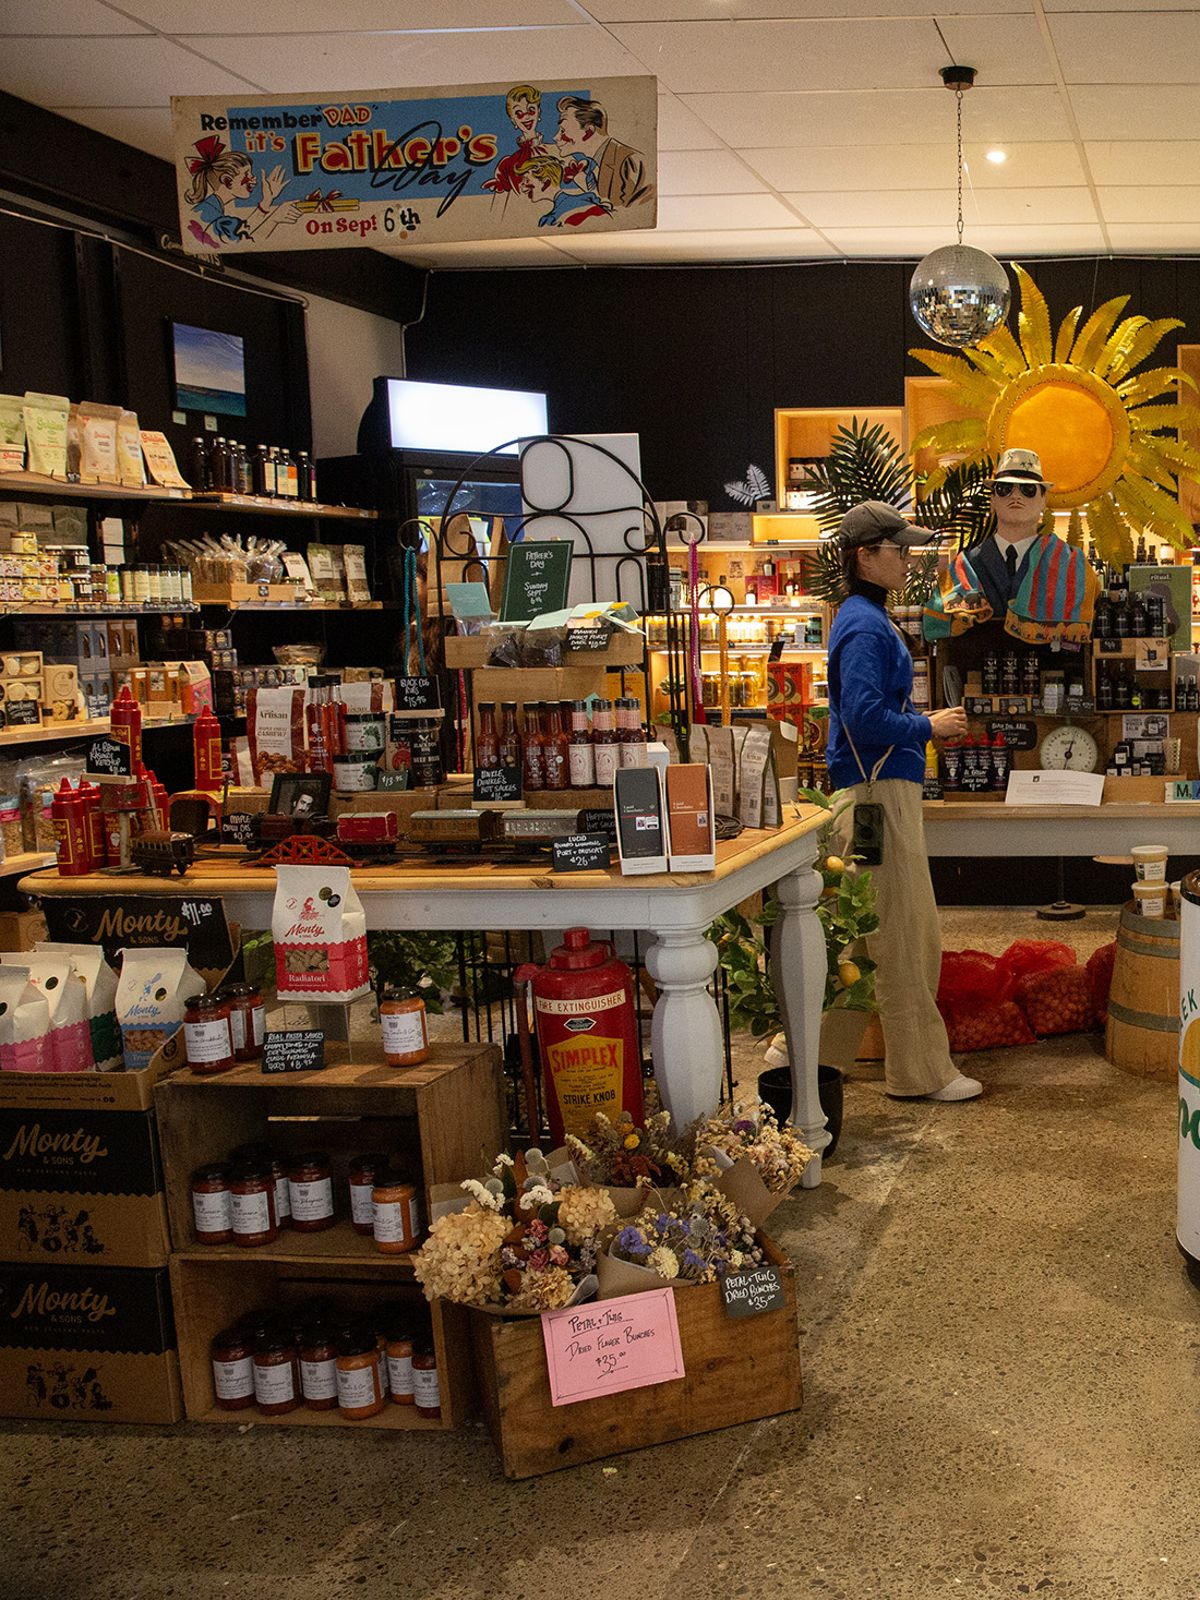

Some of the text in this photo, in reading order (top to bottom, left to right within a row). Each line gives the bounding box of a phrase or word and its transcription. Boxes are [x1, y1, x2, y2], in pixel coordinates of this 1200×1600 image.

[200, 111, 322, 132] Remember
[245, 124, 498, 175] it's Father's
[372, 120, 474, 219] Day
[306, 219, 333, 236] On
[530, 561, 545, 569] DAY
[259, 710, 288, 720] Artisan
[91, 907, 189, 942] Monty
[285, 923, 325, 937] Monty
[137, 936, 159, 944] SONS
[288, 974, 326, 982] Radiatori
[124, 1004, 161, 1018] Monty
[558, 994, 623, 1012] EXTINGUISHER
[551, 1043, 618, 1073] SIMPLEX
[563, 1089, 616, 1104] STRIKE KNOB
[3, 1123, 108, 1164] Monty
[51, 1157, 74, 1165] SONS
[725, 1270, 776, 1289] PETAL TWIG
[9, 1281, 116, 1322] Monty
[568, 1309, 623, 1333] PETAL TWIG
[565, 1341, 592, 1362] DRIED
[623, 1326, 655, 1344] BUNCHES
